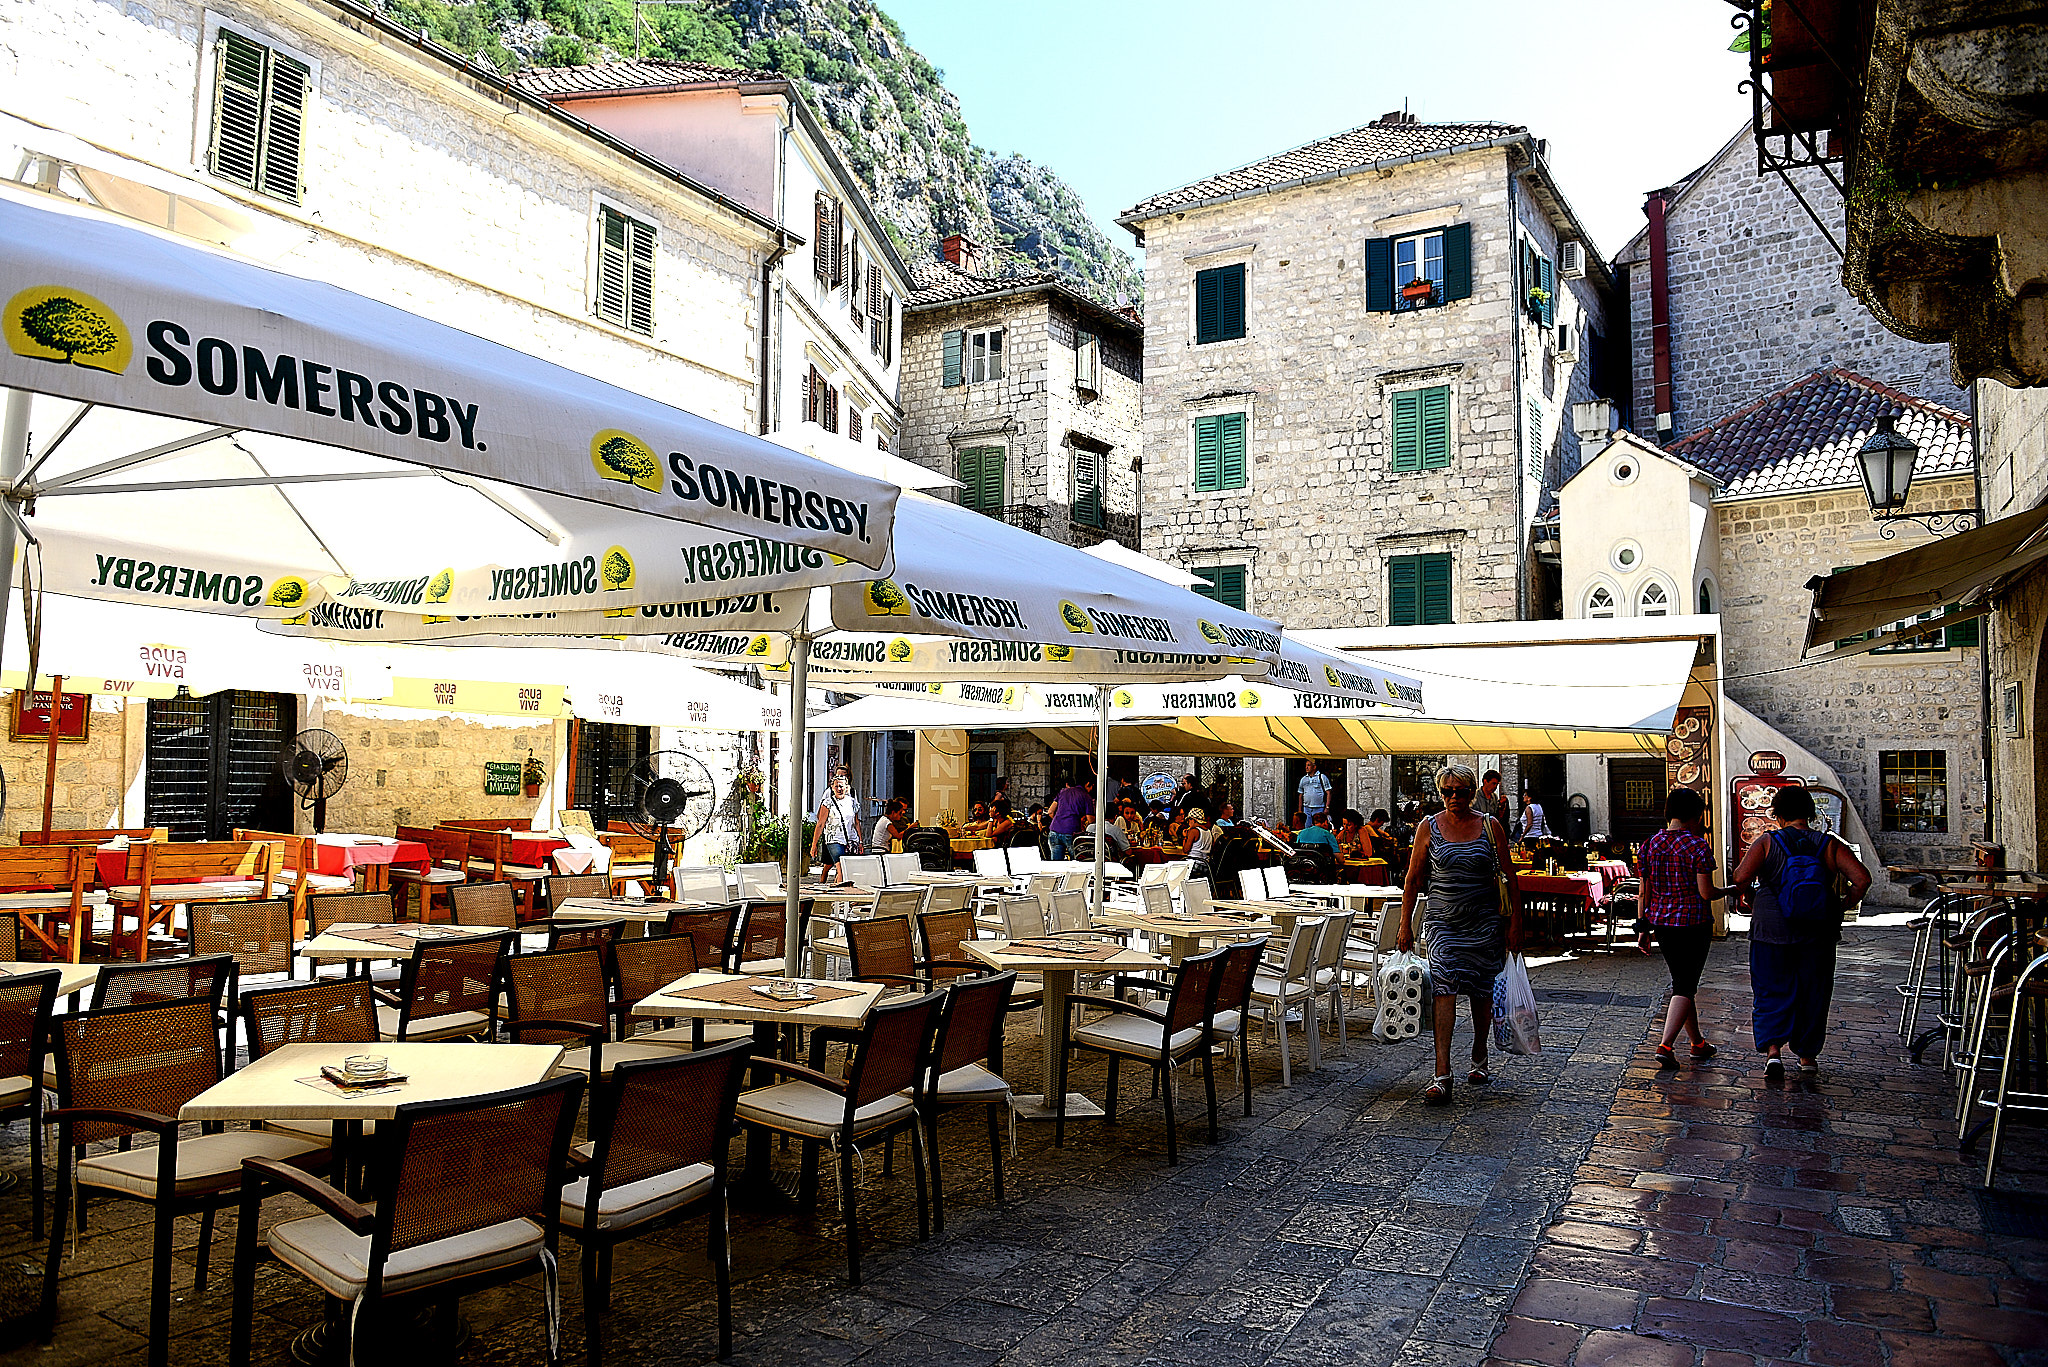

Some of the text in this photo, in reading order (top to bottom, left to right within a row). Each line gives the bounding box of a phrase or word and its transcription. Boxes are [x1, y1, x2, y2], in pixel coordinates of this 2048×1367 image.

[145, 320, 488, 453] SOMERSBY.
[668, 452, 872, 544] SOMERSBY.
[905, 583, 1029, 630] SOMERSBY.
[1087, 607, 1179, 643] SOMERSBY.
[146, 662, 184, 678] viva
[307, 677, 340, 691] viva
[34, 694, 72, 702] ANTIES
[435, 694, 456, 705] viva
[519, 698, 540, 711] viva
[1753, 759, 1781, 770] KANTUN
